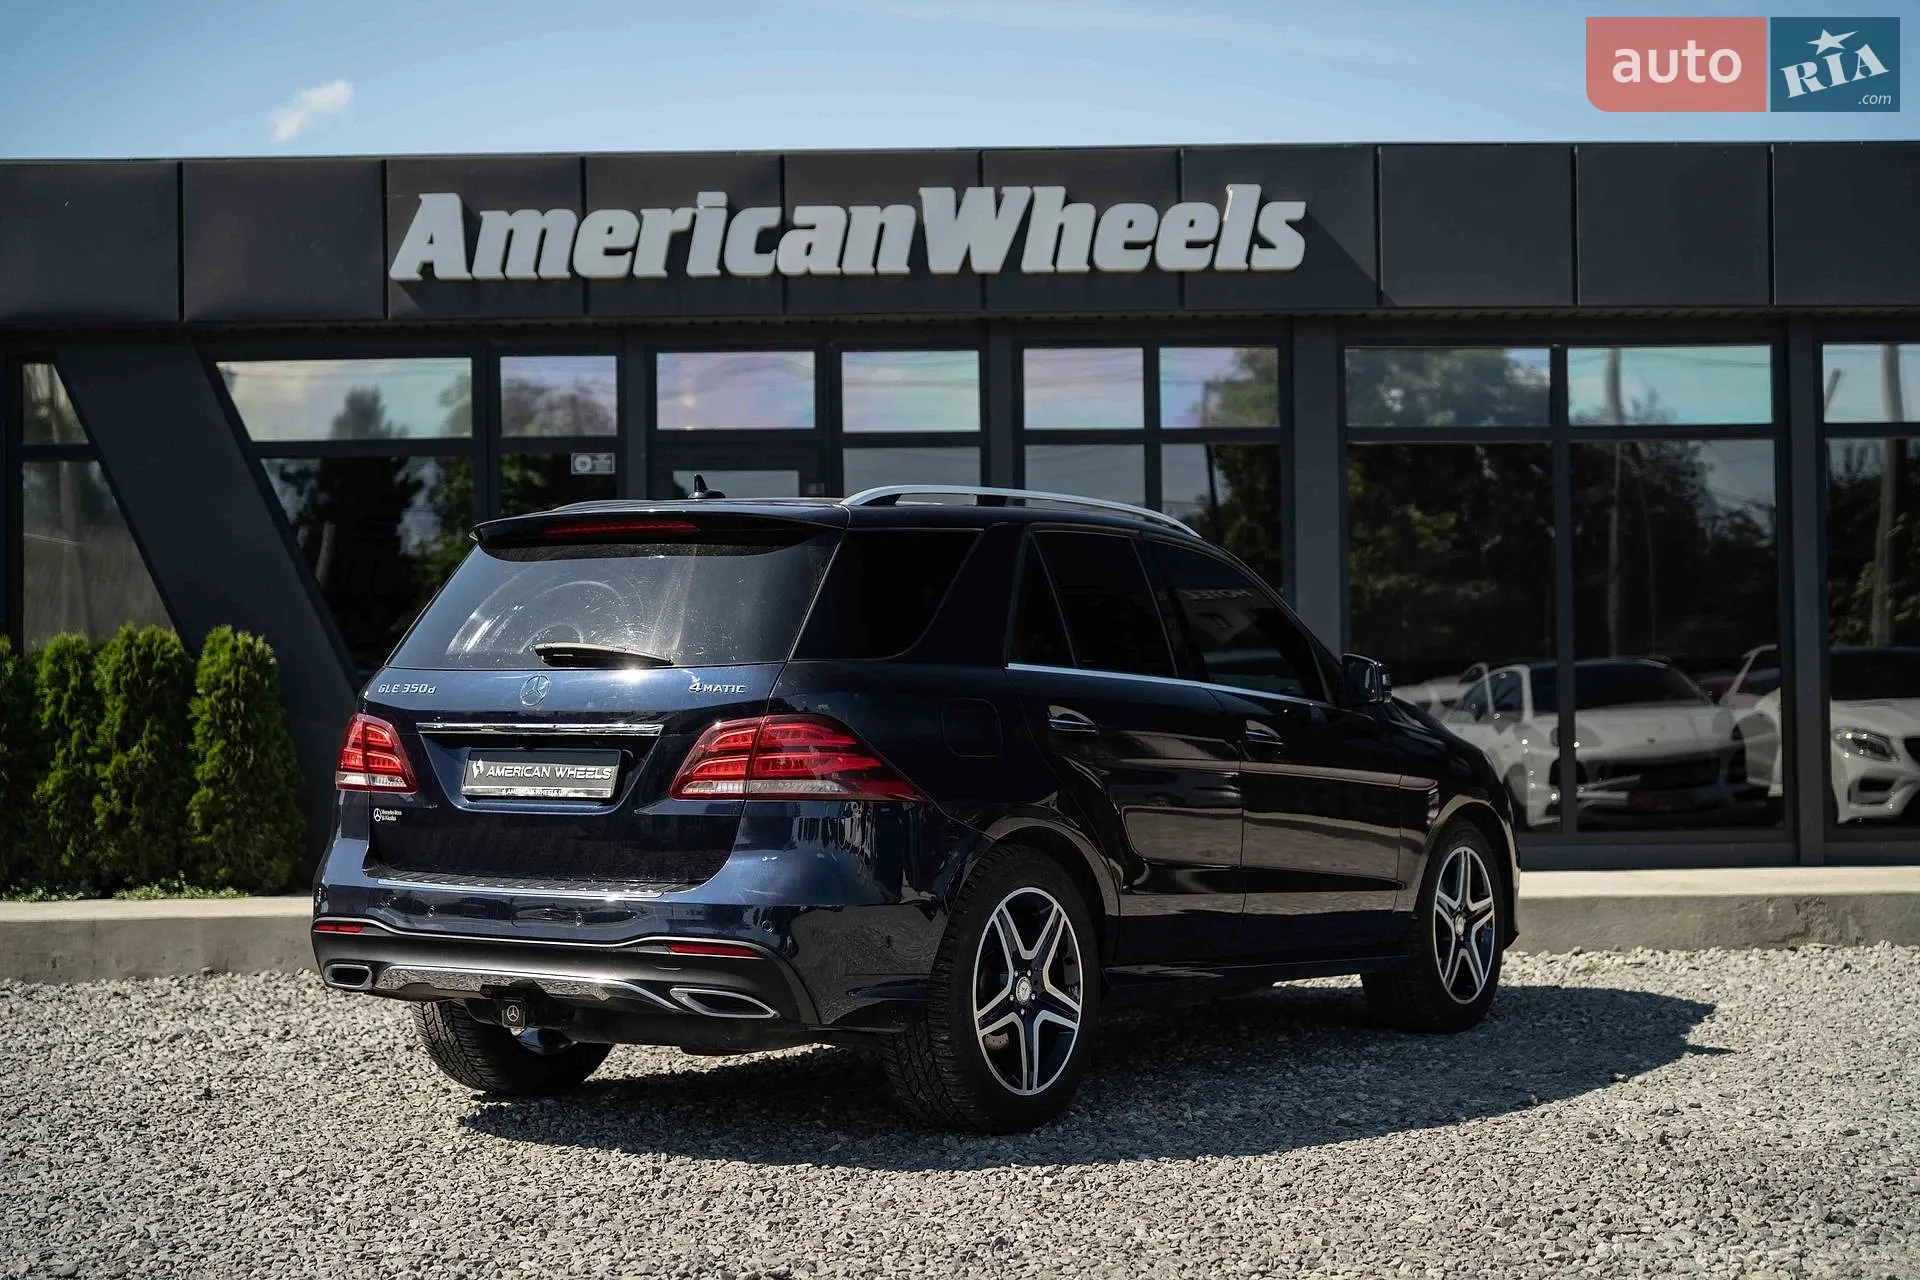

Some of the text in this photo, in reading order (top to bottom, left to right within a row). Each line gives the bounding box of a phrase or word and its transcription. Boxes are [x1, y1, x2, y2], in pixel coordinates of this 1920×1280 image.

[389, 183, 1307, 280] AmericanWheels
[378, 684, 437, 694] GLE 350d
[688, 682, 747, 693] 4MATIC
[486, 765, 612, 780] AMERICAN WHEELS
